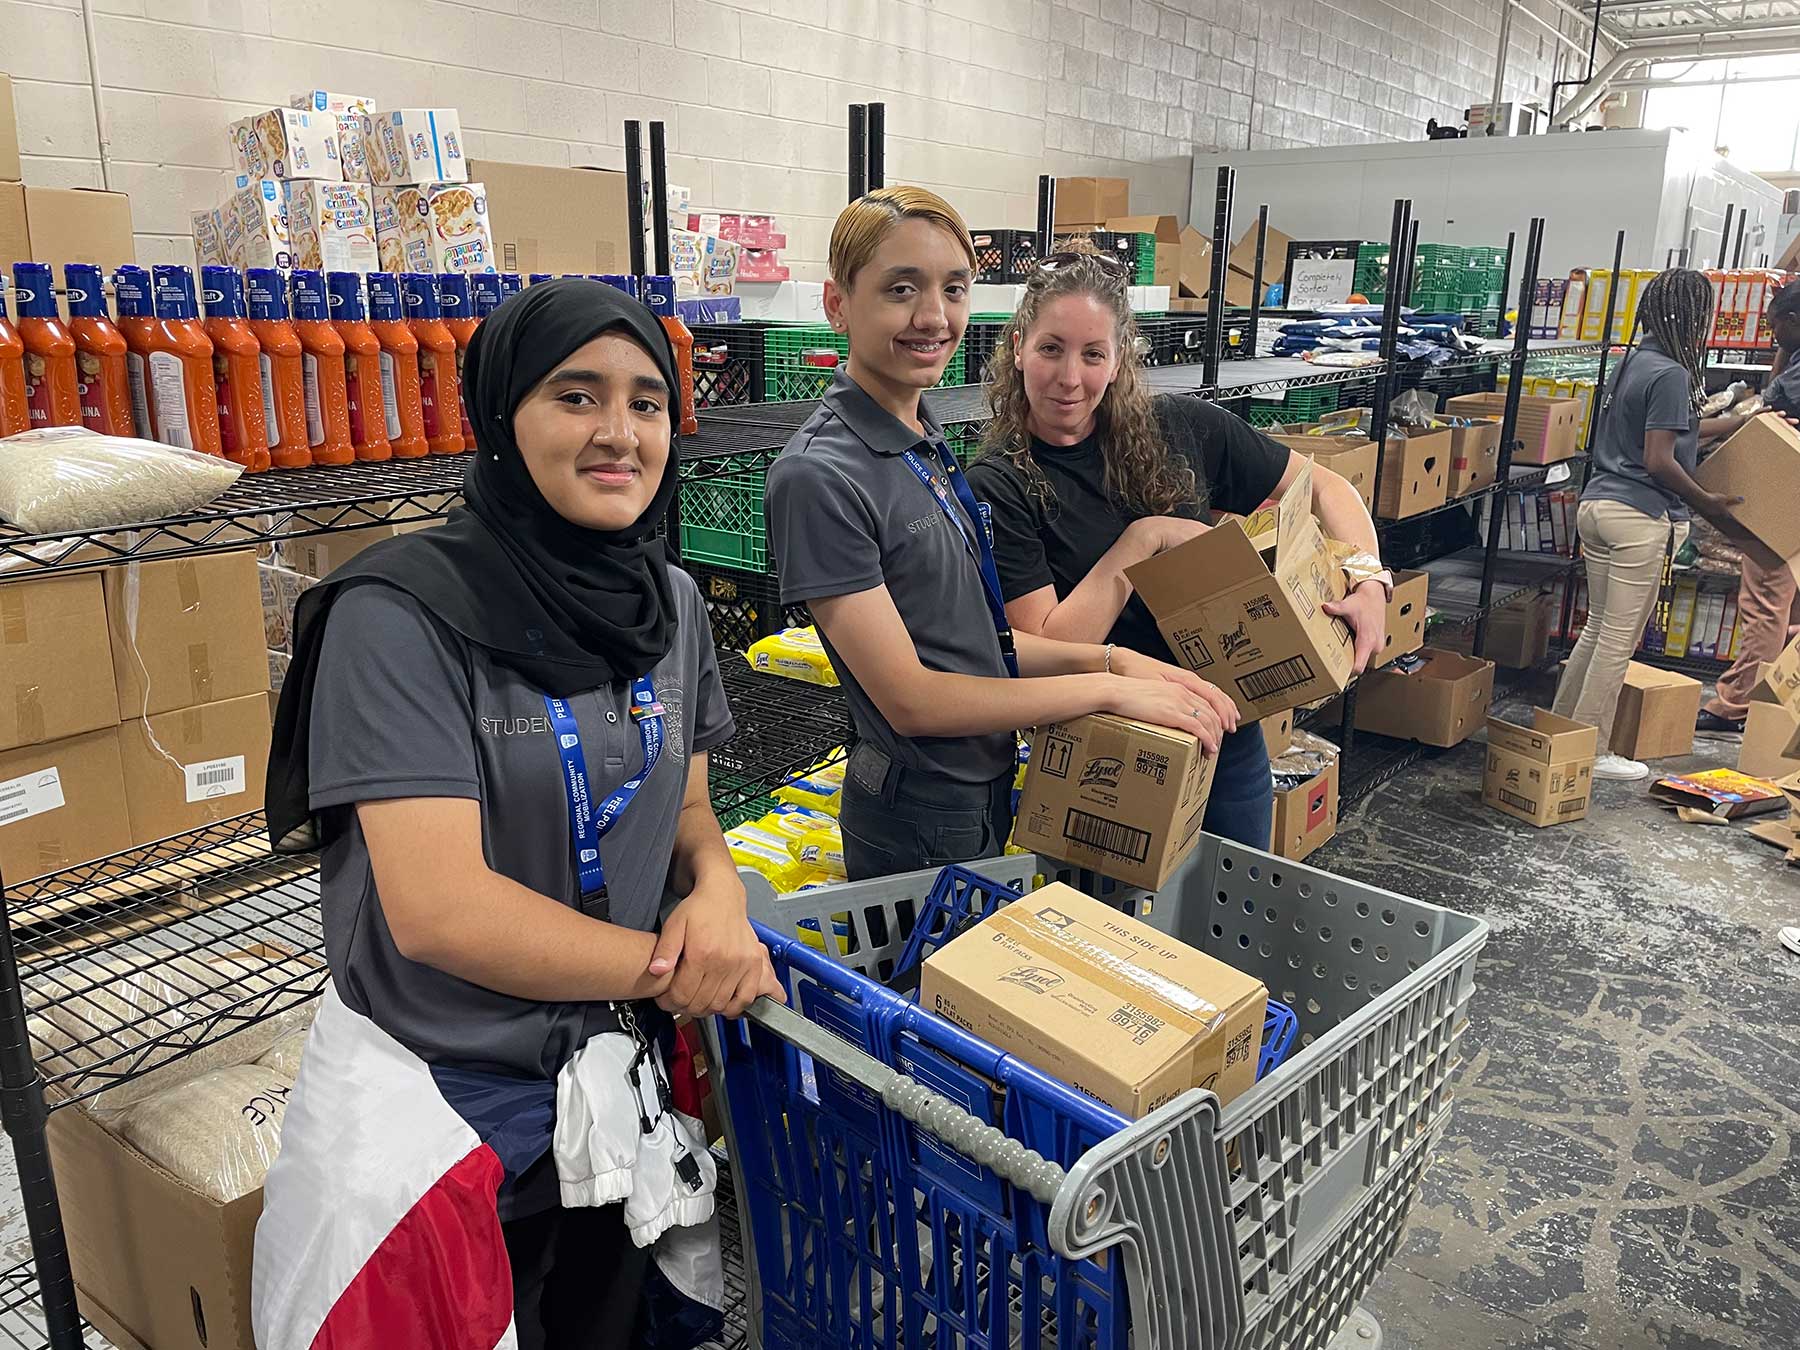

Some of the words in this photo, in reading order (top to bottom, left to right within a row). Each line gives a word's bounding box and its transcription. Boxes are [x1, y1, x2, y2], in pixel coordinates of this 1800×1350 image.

[325, 197, 357, 209] Crunch
[335, 209, 364, 219] Croque
[336, 217, 369, 229] Cannelle
[446, 241, 483, 258] Cannelle
[452, 252, 483, 267] Croque
[1296, 283, 1328, 293] Sorted
[904, 451, 930, 482] POLICE.CA
[1250, 606, 1275, 621] 99716
[1219, 623, 1246, 652] Lysol
[481, 716, 554, 735] STUDEN
[1048, 723, 1056, 734] 6
[1137, 749, 1170, 765] 3155982
[1084, 760, 1121, 779] Lysol
[1136, 762, 1165, 778] 99716
[567, 760, 580, 803] COMMUNITY
[577, 772, 590, 822] MOBILIZATION
[575, 803, 586, 839] REGIONAL
[992, 932, 1006, 942] 6
[1103, 922, 1130, 938] THIS
[1129, 935, 1160, 952] SIDE
[1159, 950, 1178, 960] UP
[1000, 940, 1014, 952] FLAT
[1013, 948, 1033, 961] PACKS
[1010, 968, 1062, 988] Lysol
[936, 994, 942, 1009] 6
[944, 1006, 956, 1019] FLAT
[956, 1014, 973, 1031] PACKS
[1122, 1002, 1166, 1028] 3155982
[1110, 1012, 1152, 1039] 99716
